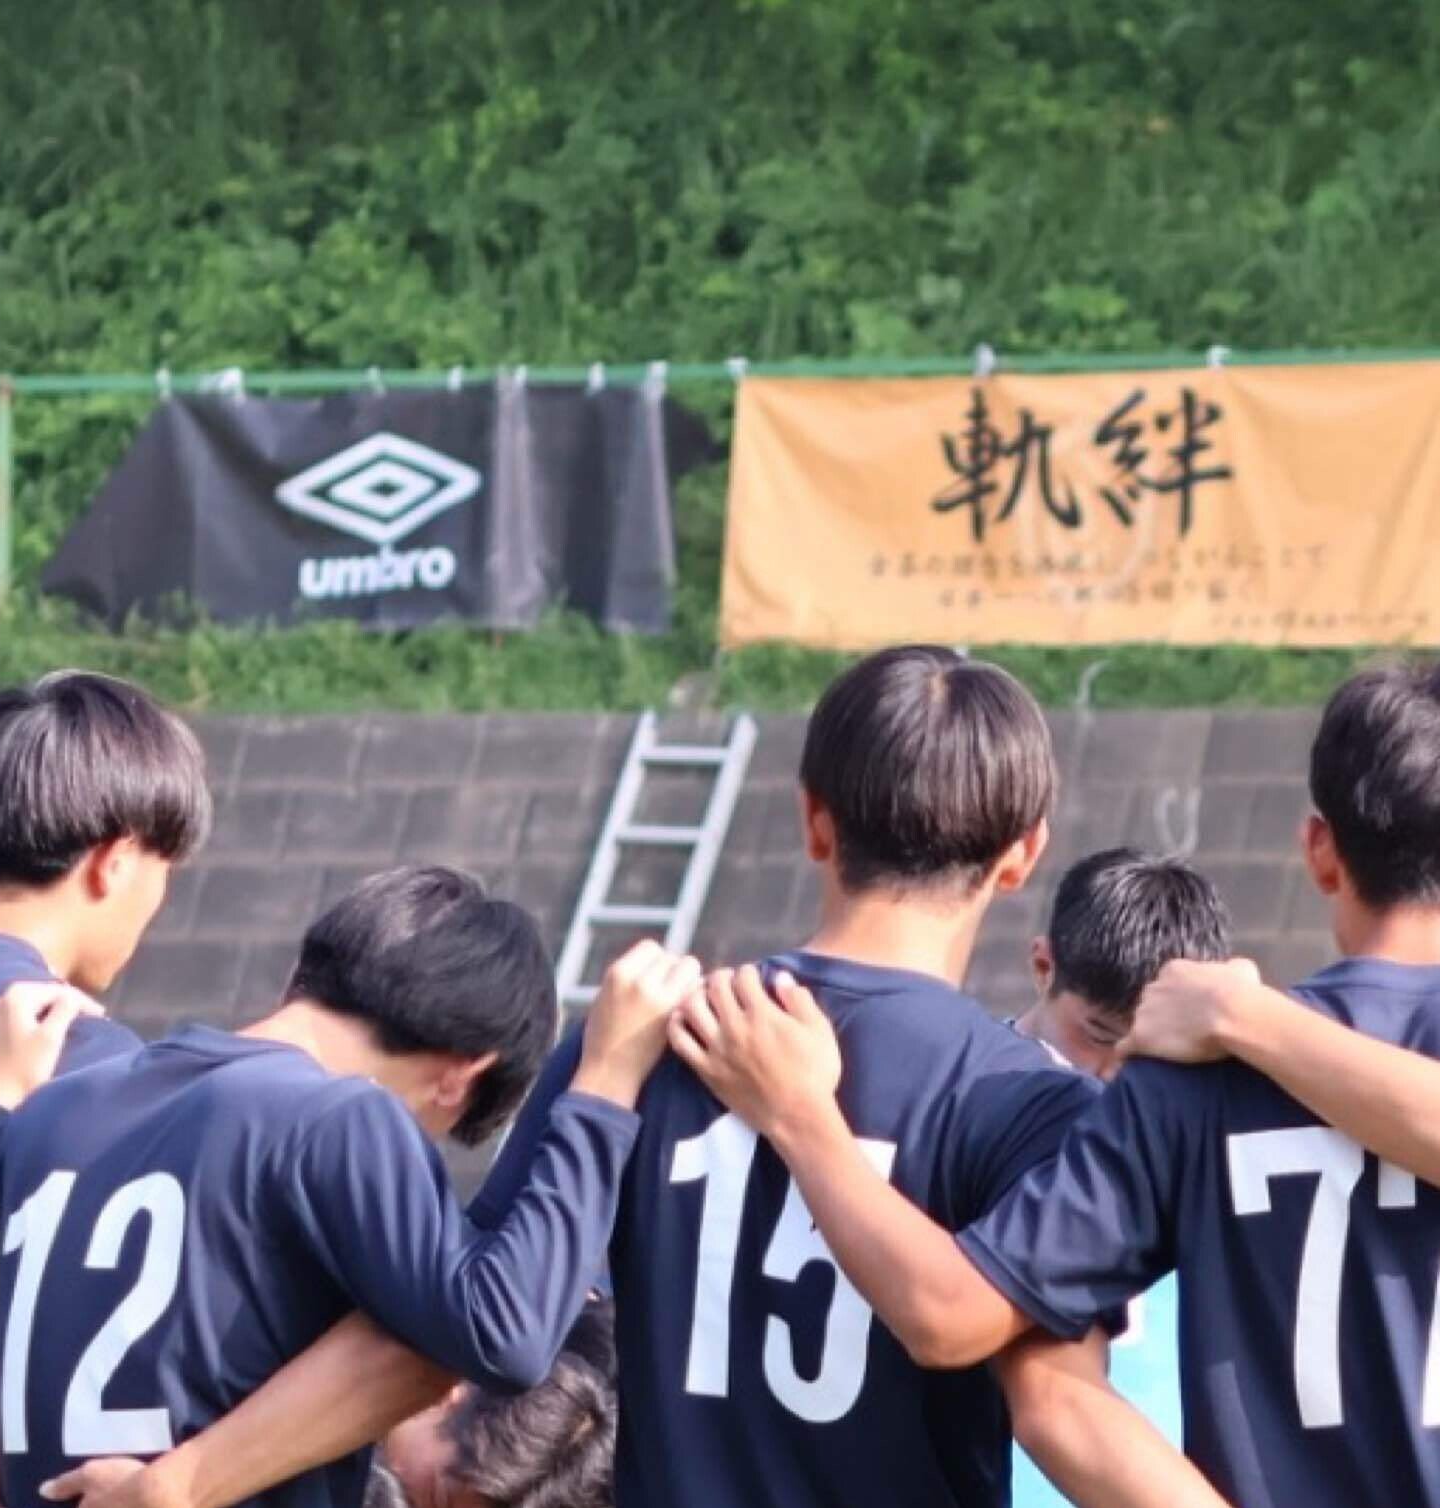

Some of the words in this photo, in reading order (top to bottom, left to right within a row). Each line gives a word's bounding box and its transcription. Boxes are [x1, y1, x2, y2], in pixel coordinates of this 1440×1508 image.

[299, 541, 456, 600] umbro
[1, 1170, 187, 1456] 12
[669, 1112, 896, 1424] 15
